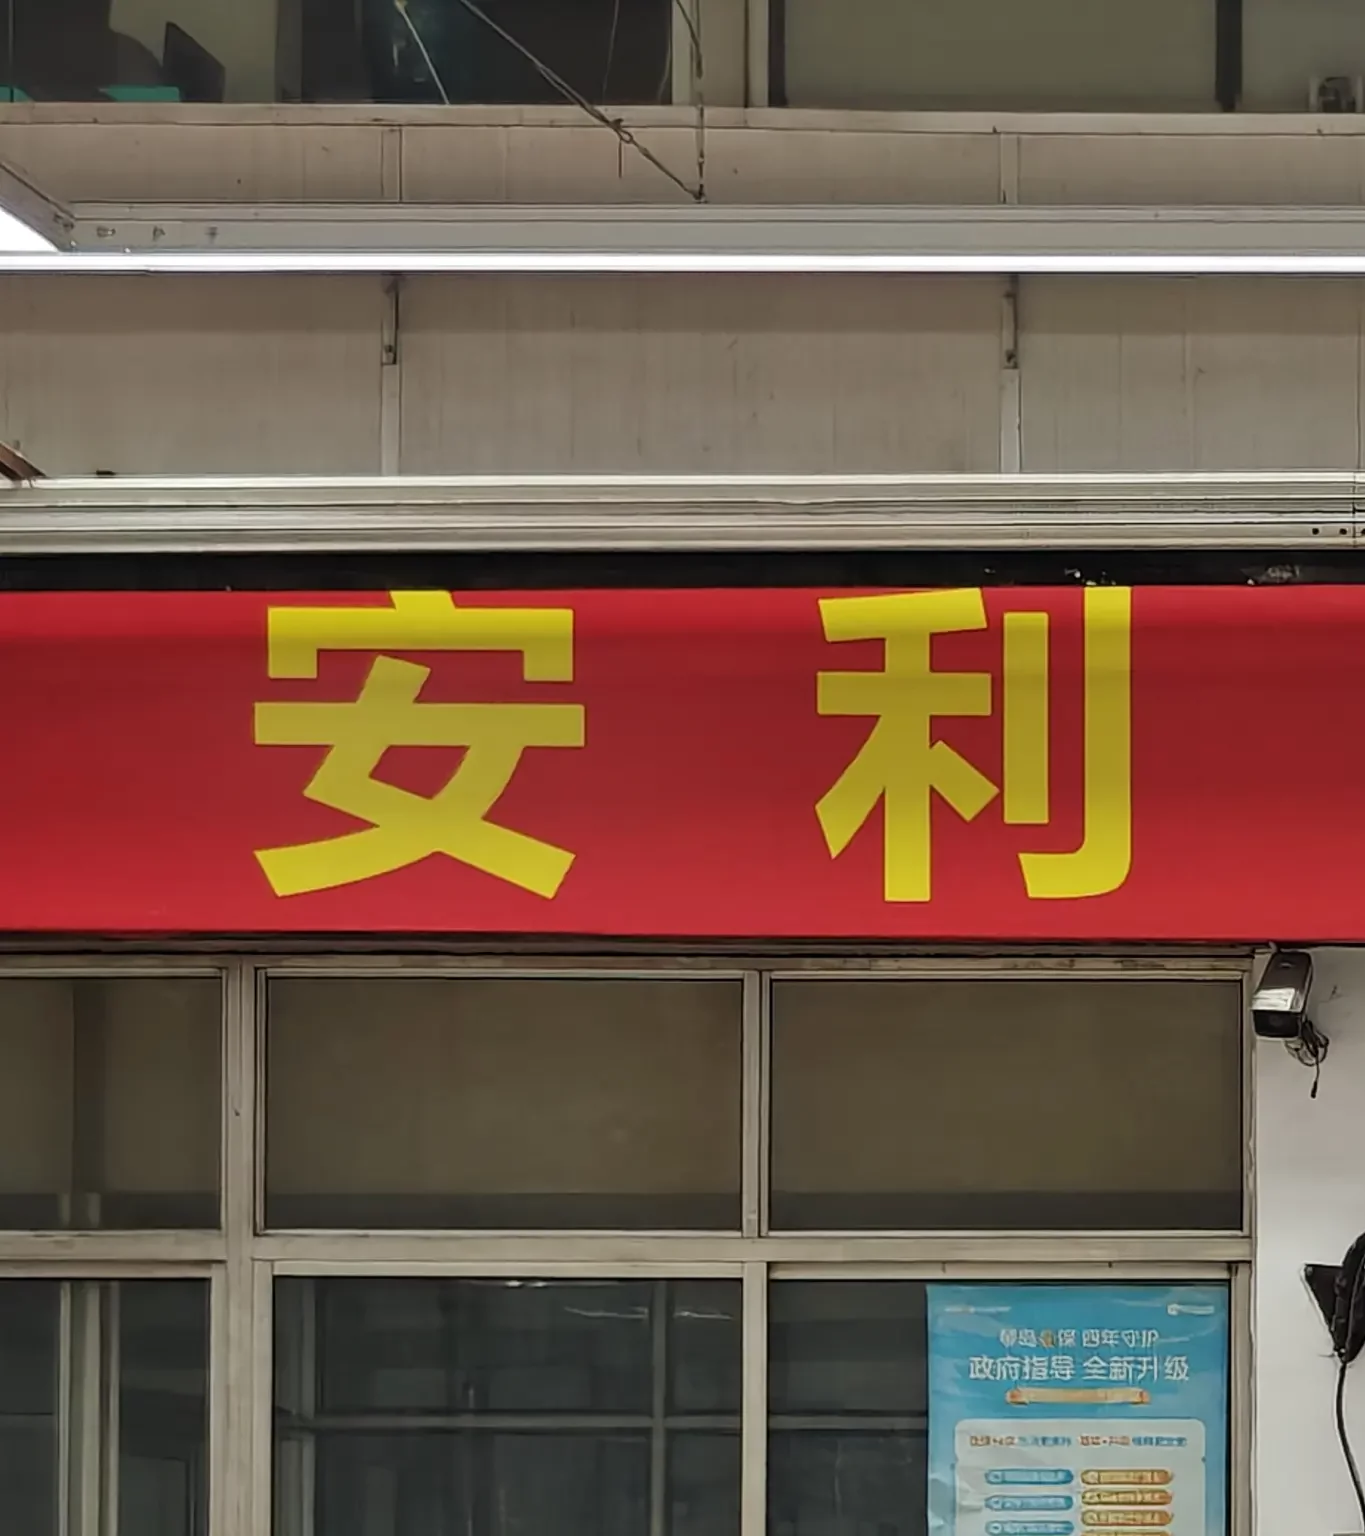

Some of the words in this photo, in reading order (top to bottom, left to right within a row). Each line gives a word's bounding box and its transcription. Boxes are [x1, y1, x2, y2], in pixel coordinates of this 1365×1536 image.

[969, 1355, 1076, 1381] 政府指导
[1081, 1356, 1189, 1383] 全新升级
